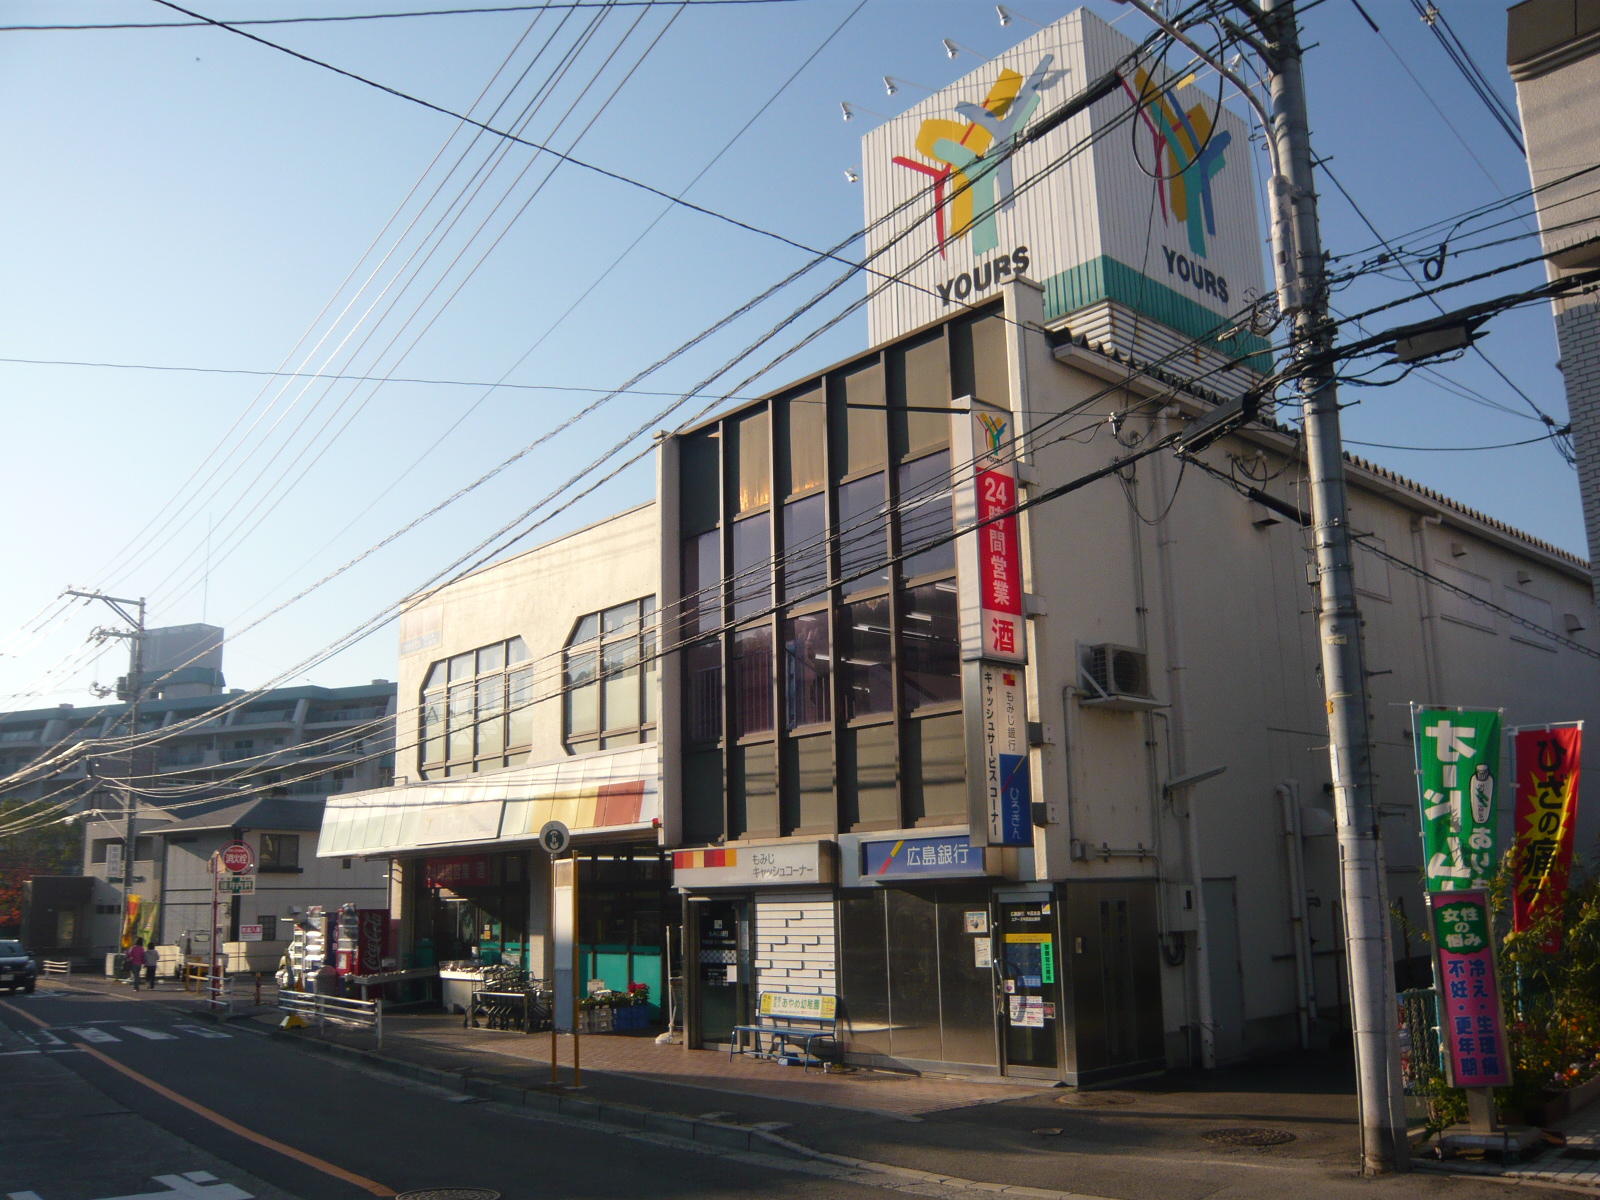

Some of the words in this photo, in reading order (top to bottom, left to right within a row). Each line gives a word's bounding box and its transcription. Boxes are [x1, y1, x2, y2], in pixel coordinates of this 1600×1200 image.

[936, 245, 1030, 306] YOURS
[1162, 245, 1230, 303] YOURS
[984, 477, 1011, 606] 24時間営業
[991, 617, 1015, 654] 酒
[1006, 691, 1016, 751] もみじ銀行
[225, 853, 248, 864] 消火栓
[752, 853, 775, 865] もみじ
[906, 843, 969, 866] 広島銀行
[752, 865, 813, 878] キャッシュコーナー
[1442, 907, 1479, 922] 女性
[1454, 922, 1470, 933] の
[1445, 933, 1482, 948] 悩み
[1447, 959, 1479, 1077] 不妊・更年期
